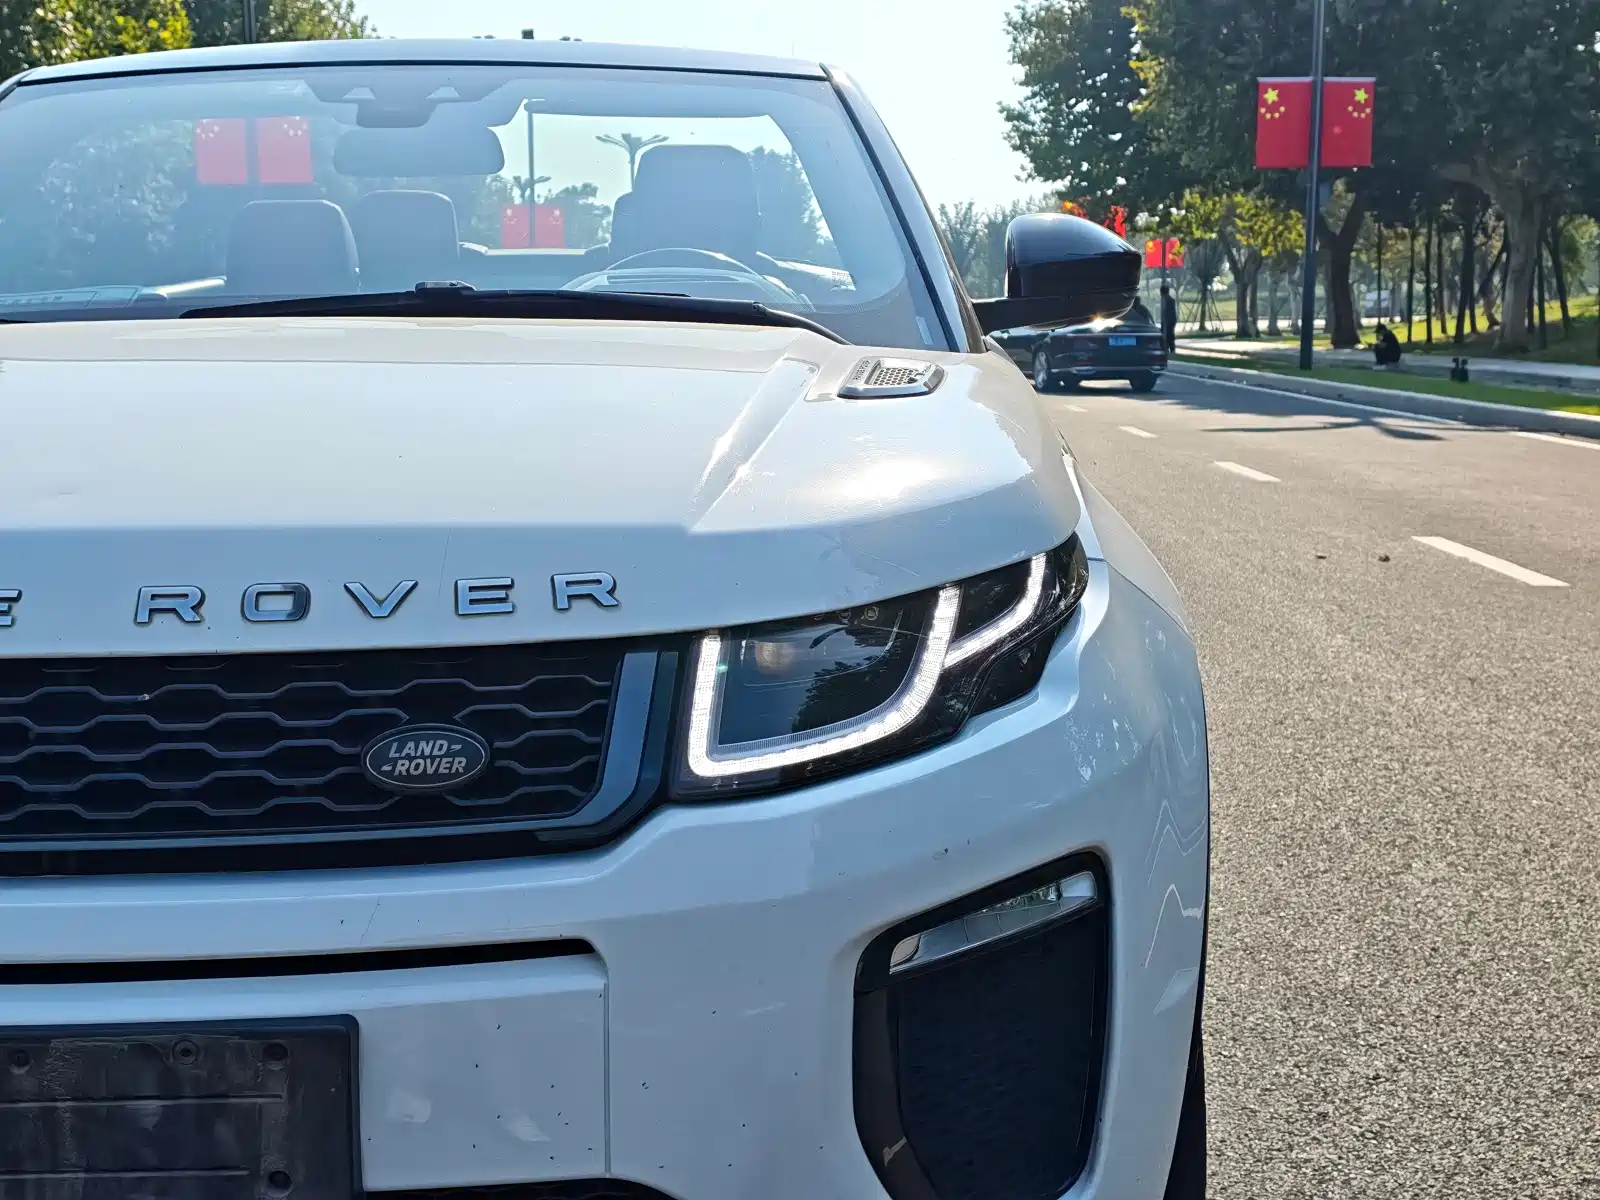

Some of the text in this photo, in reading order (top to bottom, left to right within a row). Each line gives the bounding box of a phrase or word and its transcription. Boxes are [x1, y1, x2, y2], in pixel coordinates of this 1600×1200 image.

[134, 571, 621, 624] ROVER
[388, 739, 449, 758] LAND
[393, 756, 467, 776] ROVER
